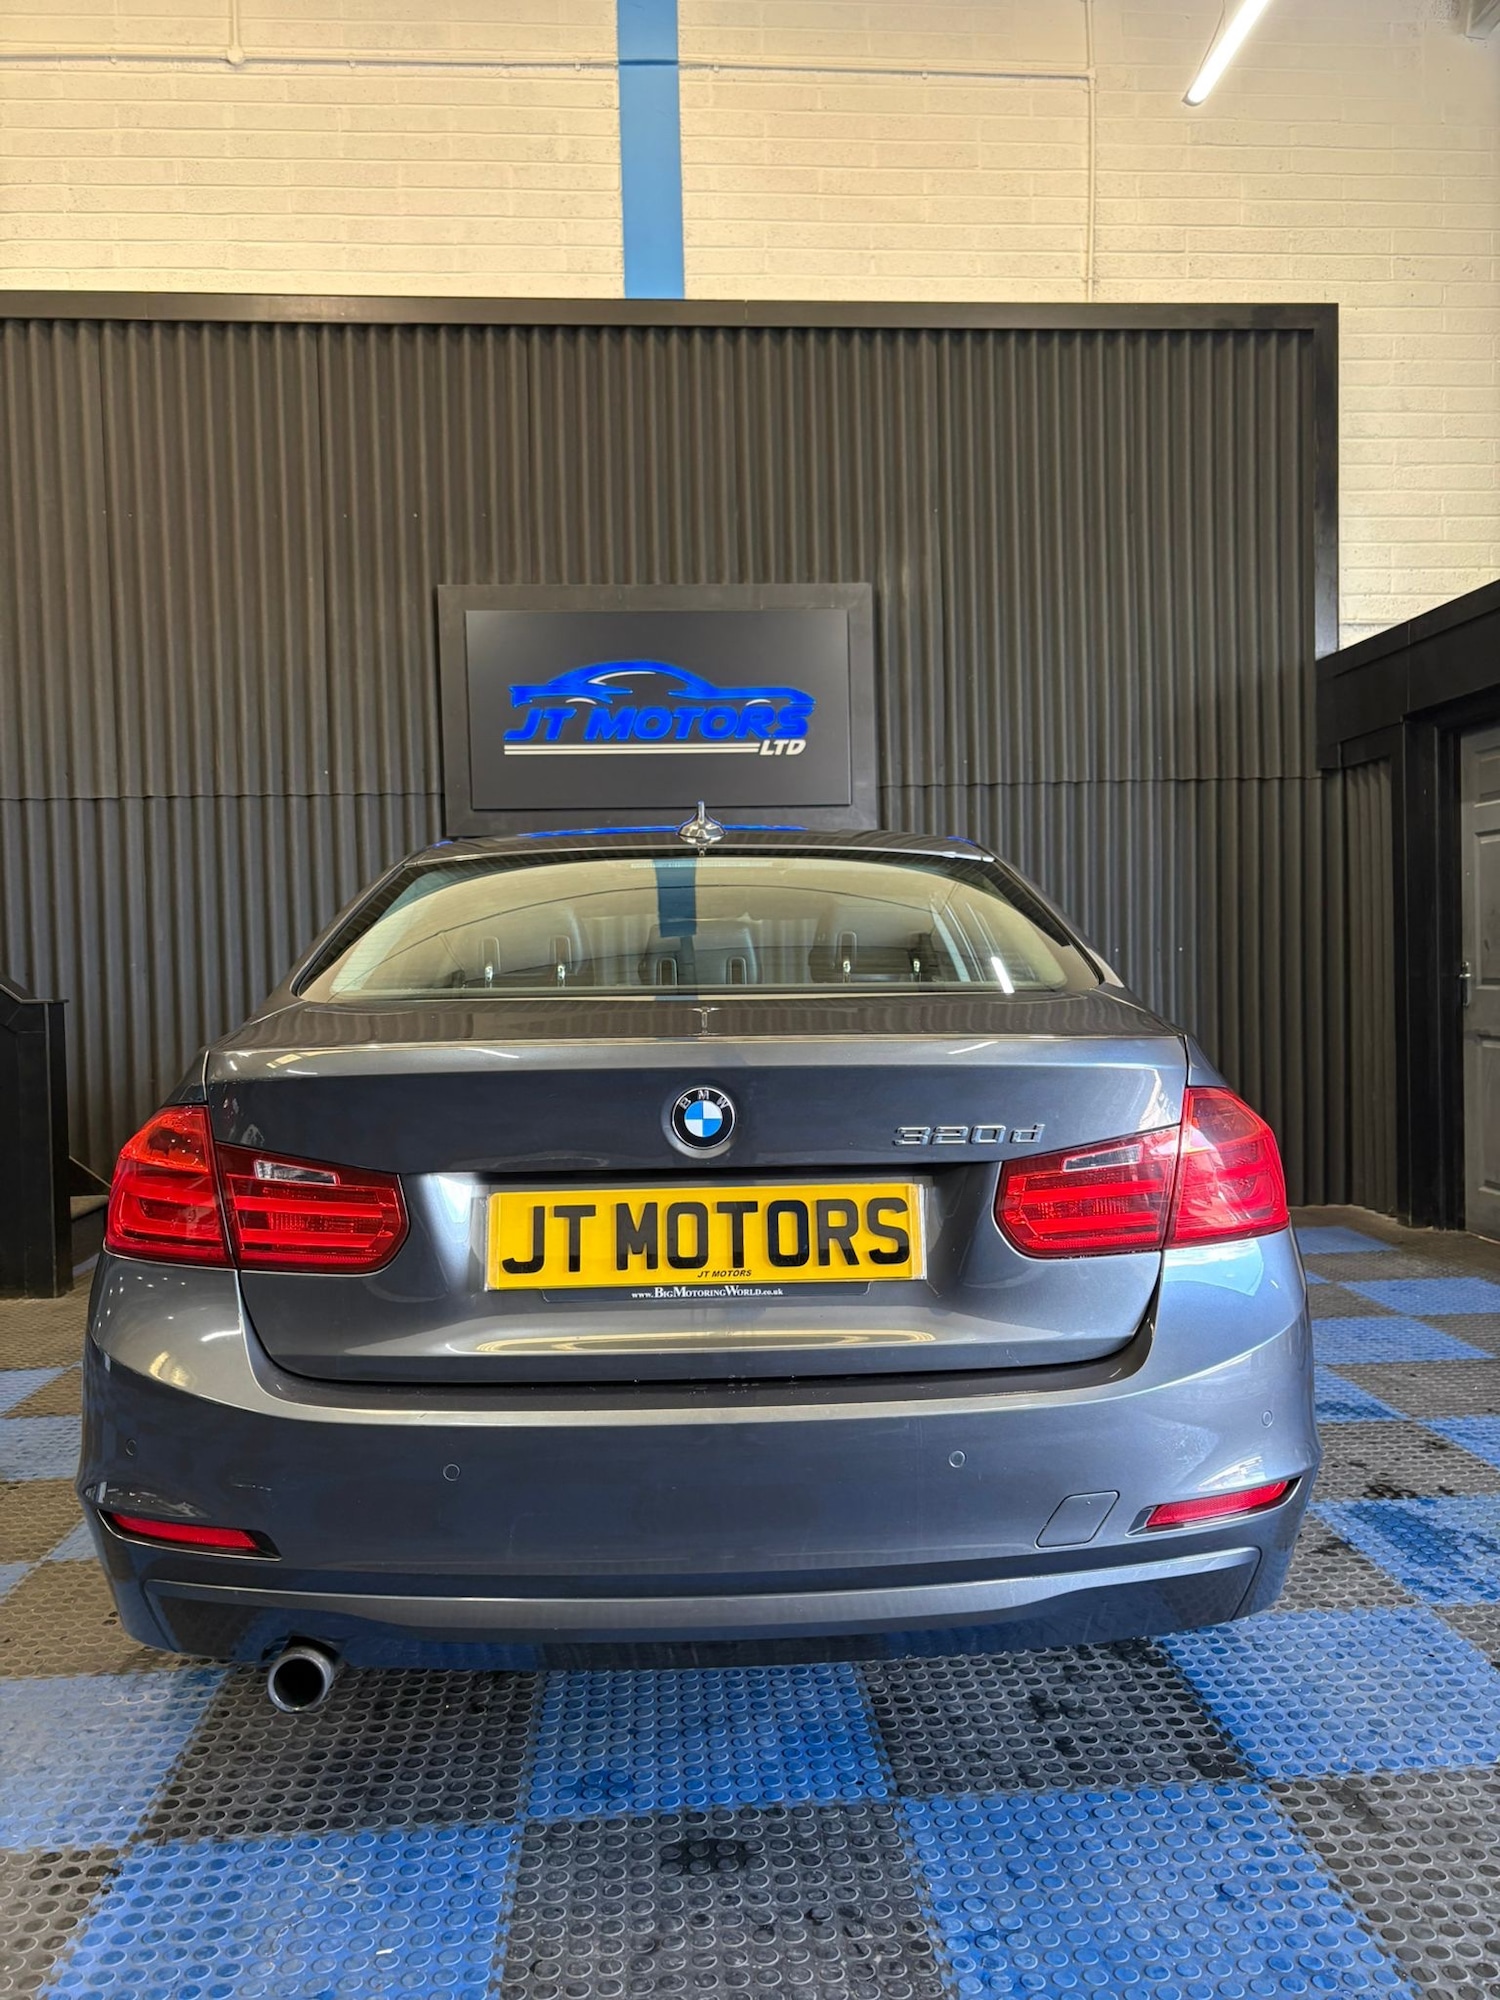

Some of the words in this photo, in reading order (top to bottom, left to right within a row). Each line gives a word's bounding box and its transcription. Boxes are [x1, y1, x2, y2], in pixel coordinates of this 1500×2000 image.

[503, 706, 577, 741] JT
[583, 705, 815, 741] MOTORS
[759, 739, 806, 756] LTD
[678, 1087, 731, 1110] BMW
[894, 1123, 1046, 1147] 320d
[501, 1204, 597, 1275] JT
[615, 1196, 911, 1272] MOTORS
[697, 1270, 709, 1279] JT
[711, 1269, 752, 1278] MOTORS
